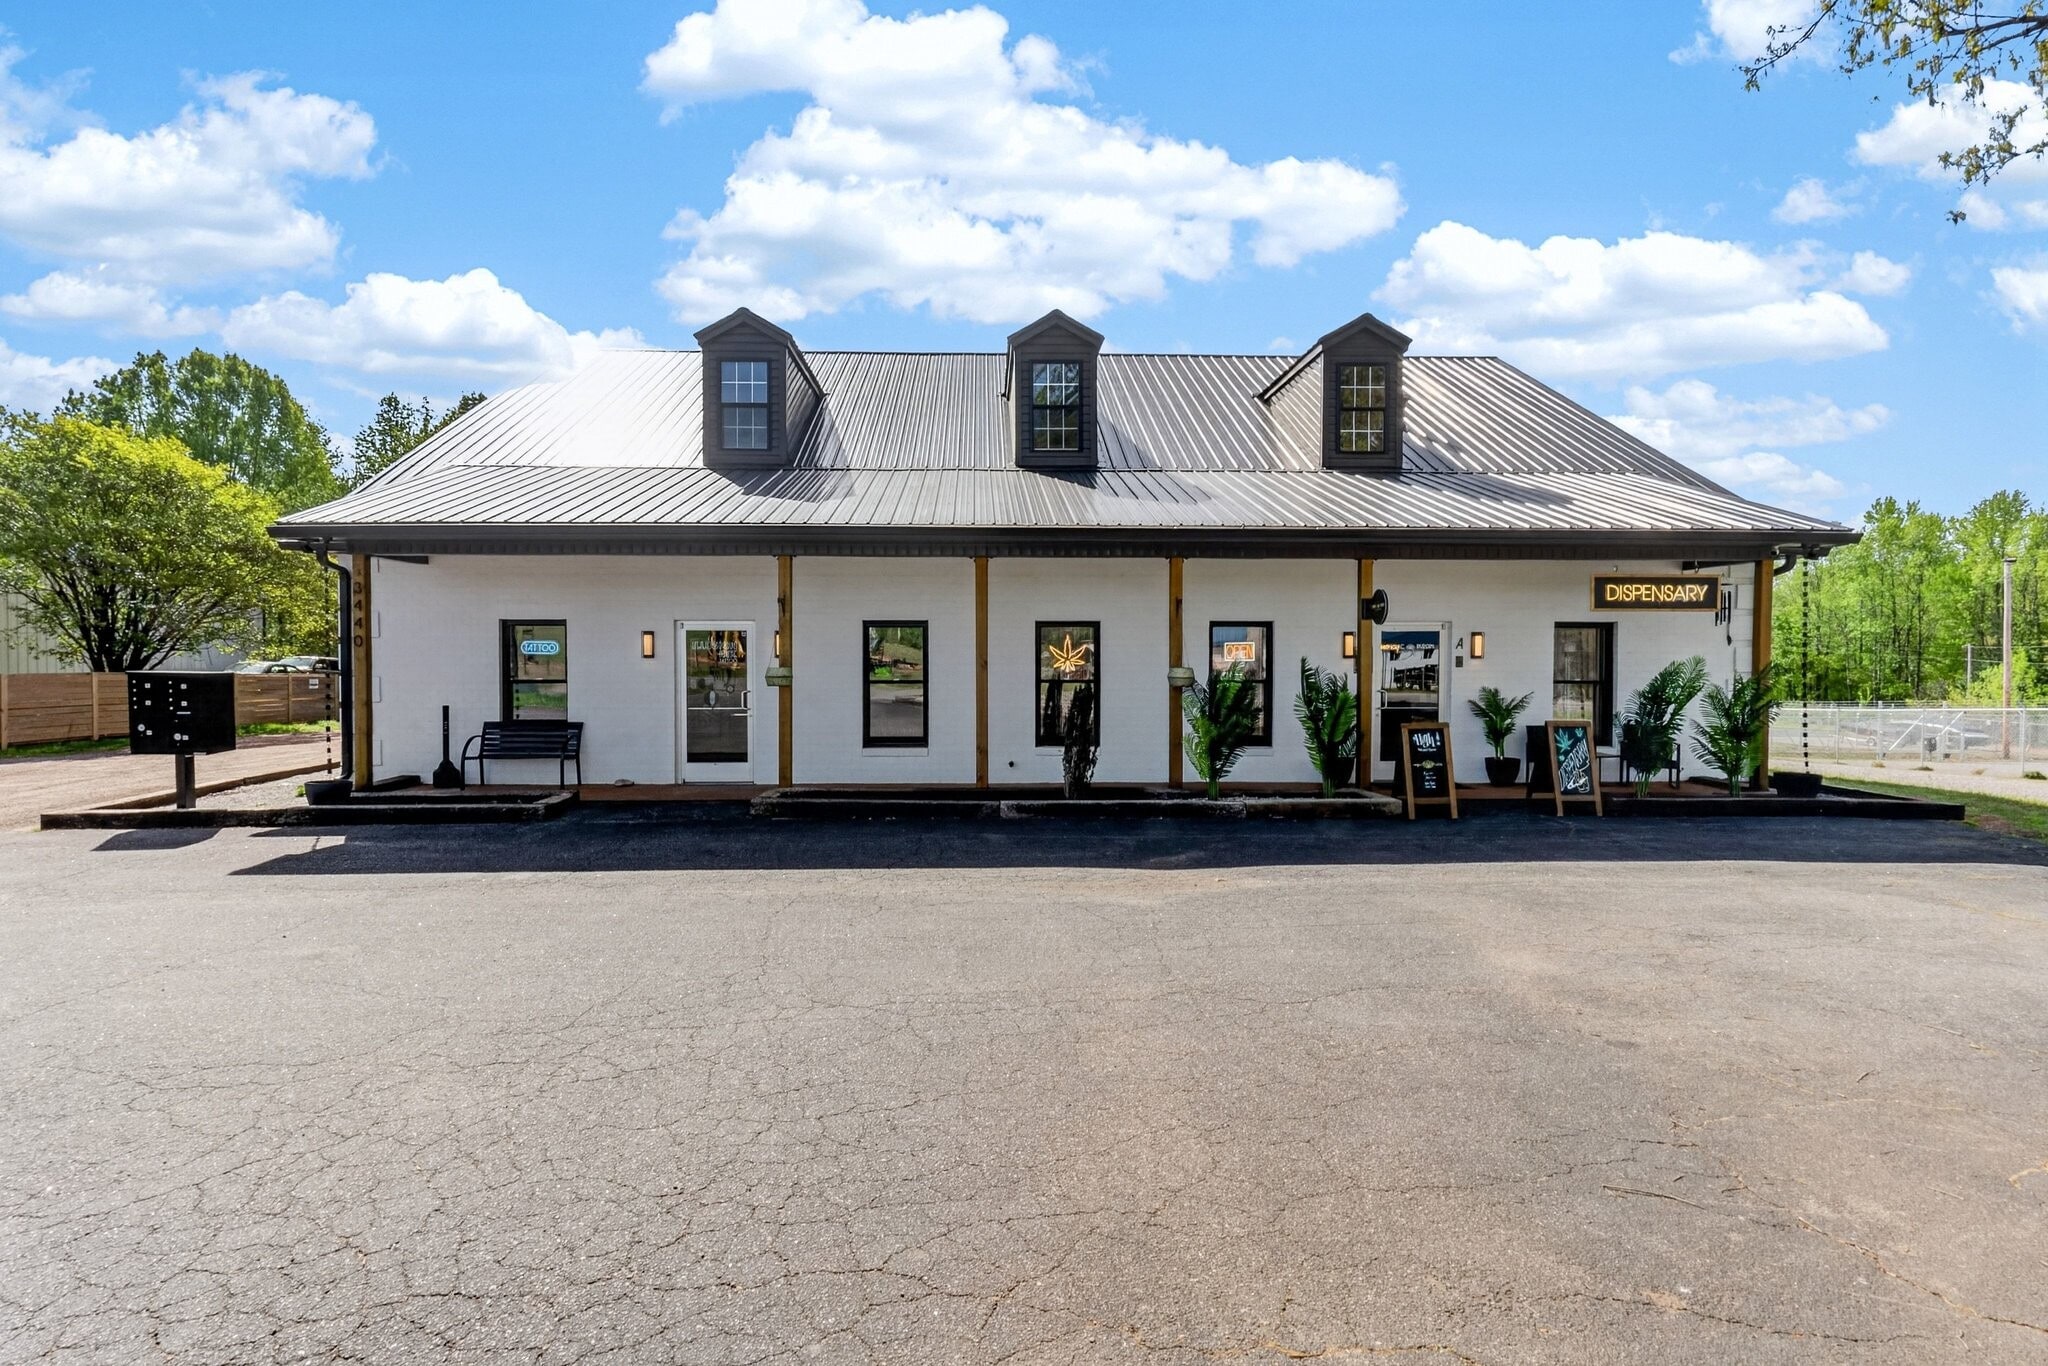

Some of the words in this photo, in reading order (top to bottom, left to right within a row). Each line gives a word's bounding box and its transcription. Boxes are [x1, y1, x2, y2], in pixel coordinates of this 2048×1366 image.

[1605, 584, 1709, 602] DISPENSARY
[353, 581, 363, 648] 3440
[523, 643, 557, 653] TATTOO
[1455, 637, 1464, 650] A
[1226, 645, 1254, 659] OPEN
